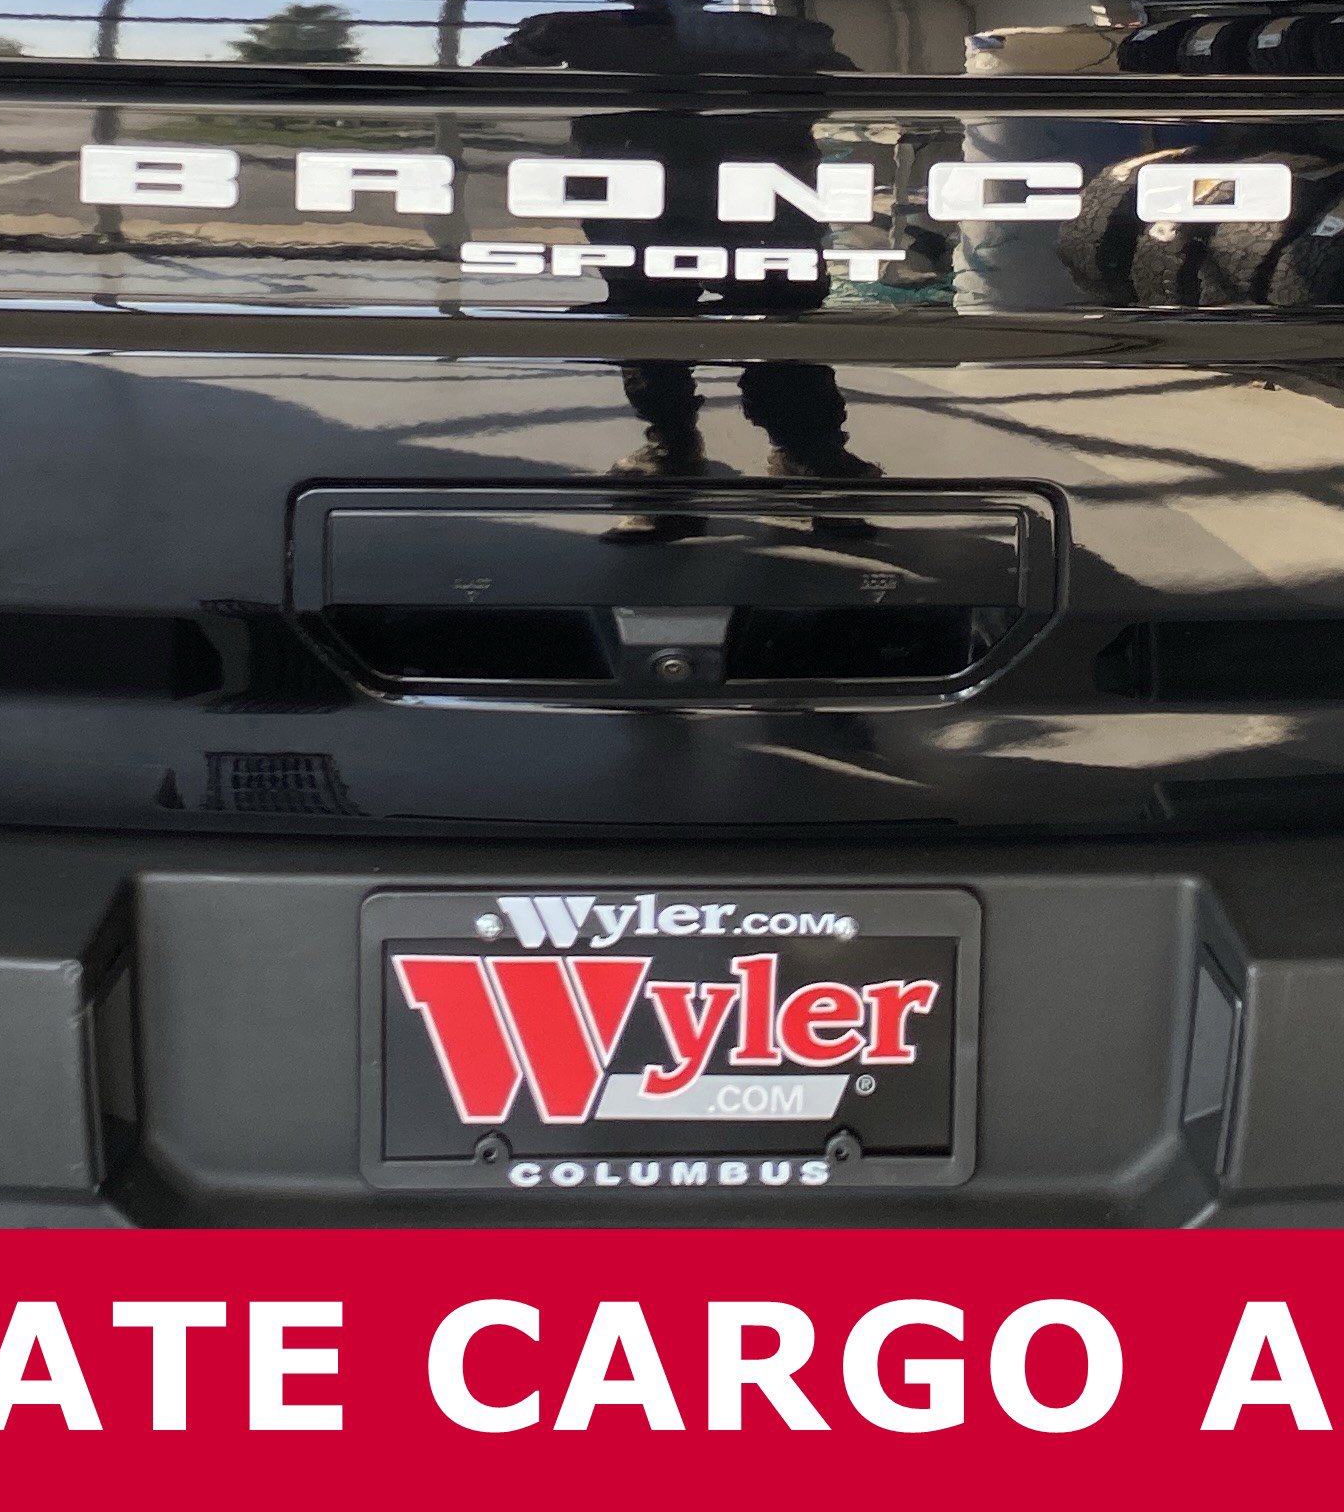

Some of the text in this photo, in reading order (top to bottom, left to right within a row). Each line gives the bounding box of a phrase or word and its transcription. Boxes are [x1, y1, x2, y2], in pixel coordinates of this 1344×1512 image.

[80, 144, 1292, 223] BRONCO
[459, 241, 907, 282] SPORT
[392, 952, 941, 1125] Wyler
[706, 1082, 805, 1115] .COM
[508, 1159, 832, 1188] COLUMBUS
